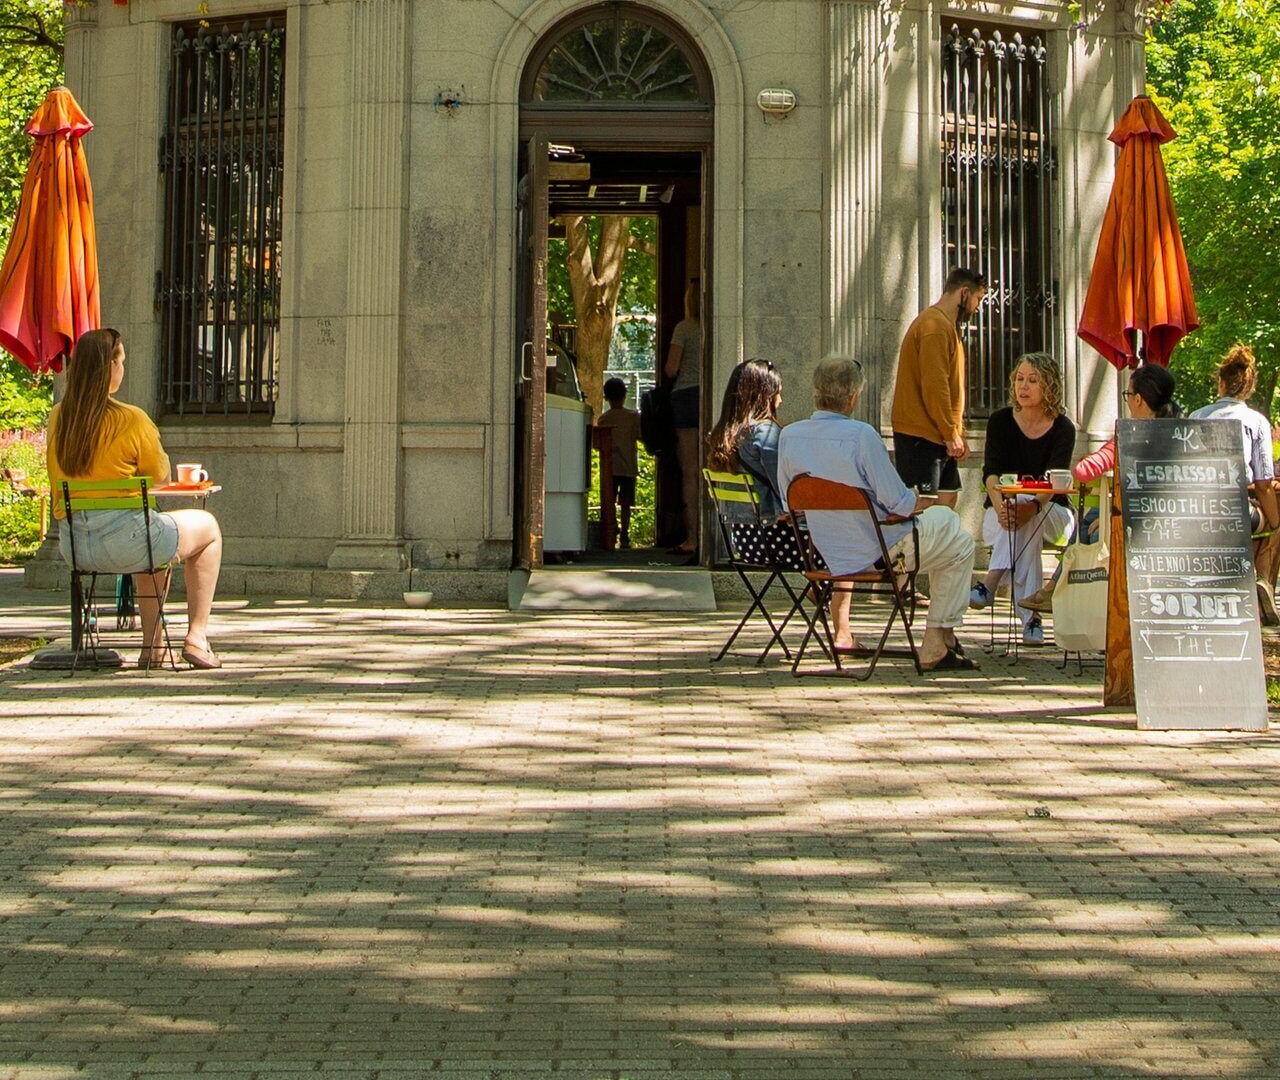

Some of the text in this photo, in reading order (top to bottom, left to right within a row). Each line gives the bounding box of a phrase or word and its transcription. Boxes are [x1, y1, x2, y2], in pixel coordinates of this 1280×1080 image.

[1145, 465, 1217, 482] ESPRESSO
[1142, 530, 1182, 541] THE
[1150, 593, 1241, 618] SORBET
[1174, 635, 1215, 655] THE
